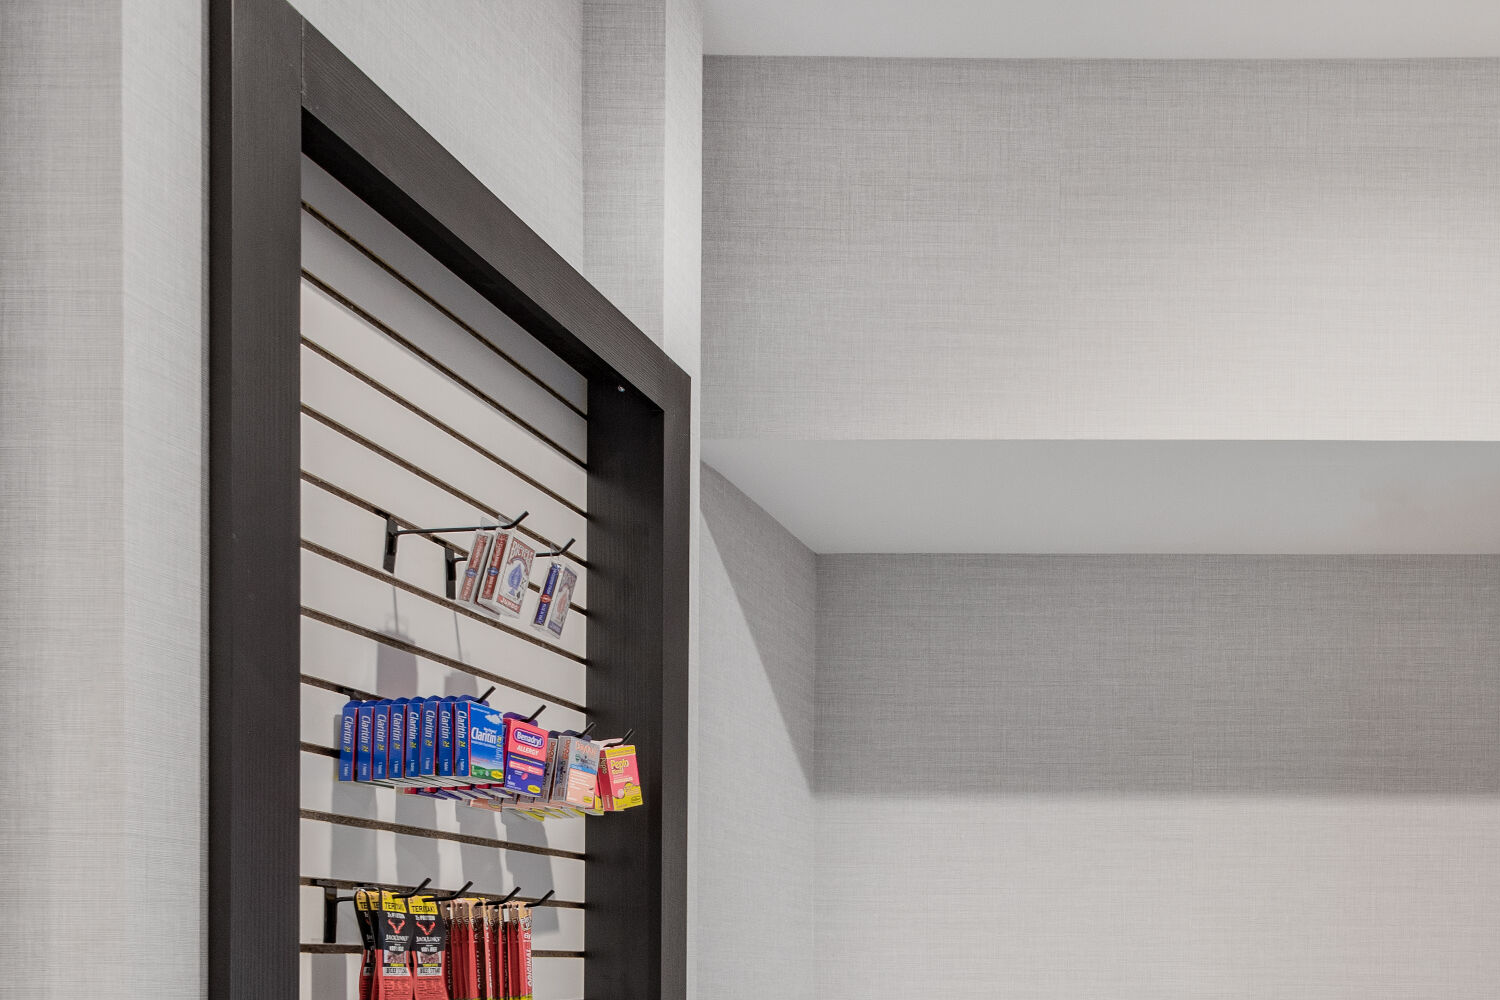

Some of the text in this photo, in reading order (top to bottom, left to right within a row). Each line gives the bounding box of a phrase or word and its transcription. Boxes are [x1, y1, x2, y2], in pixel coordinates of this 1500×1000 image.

[343, 716, 353, 744] Claritin
[361, 715, 370, 747] Claritin
[377, 714, 387, 742] Claritin
[393, 713, 403, 741] Claritin
[408, 711, 419, 740] Claritin
[425, 710, 435, 738] Claritin
[441, 710, 451, 739] Claritin
[457, 710, 467, 739] Claritin
[471, 726, 497, 745] Claritin
[516, 730, 543, 747] Benadryl
